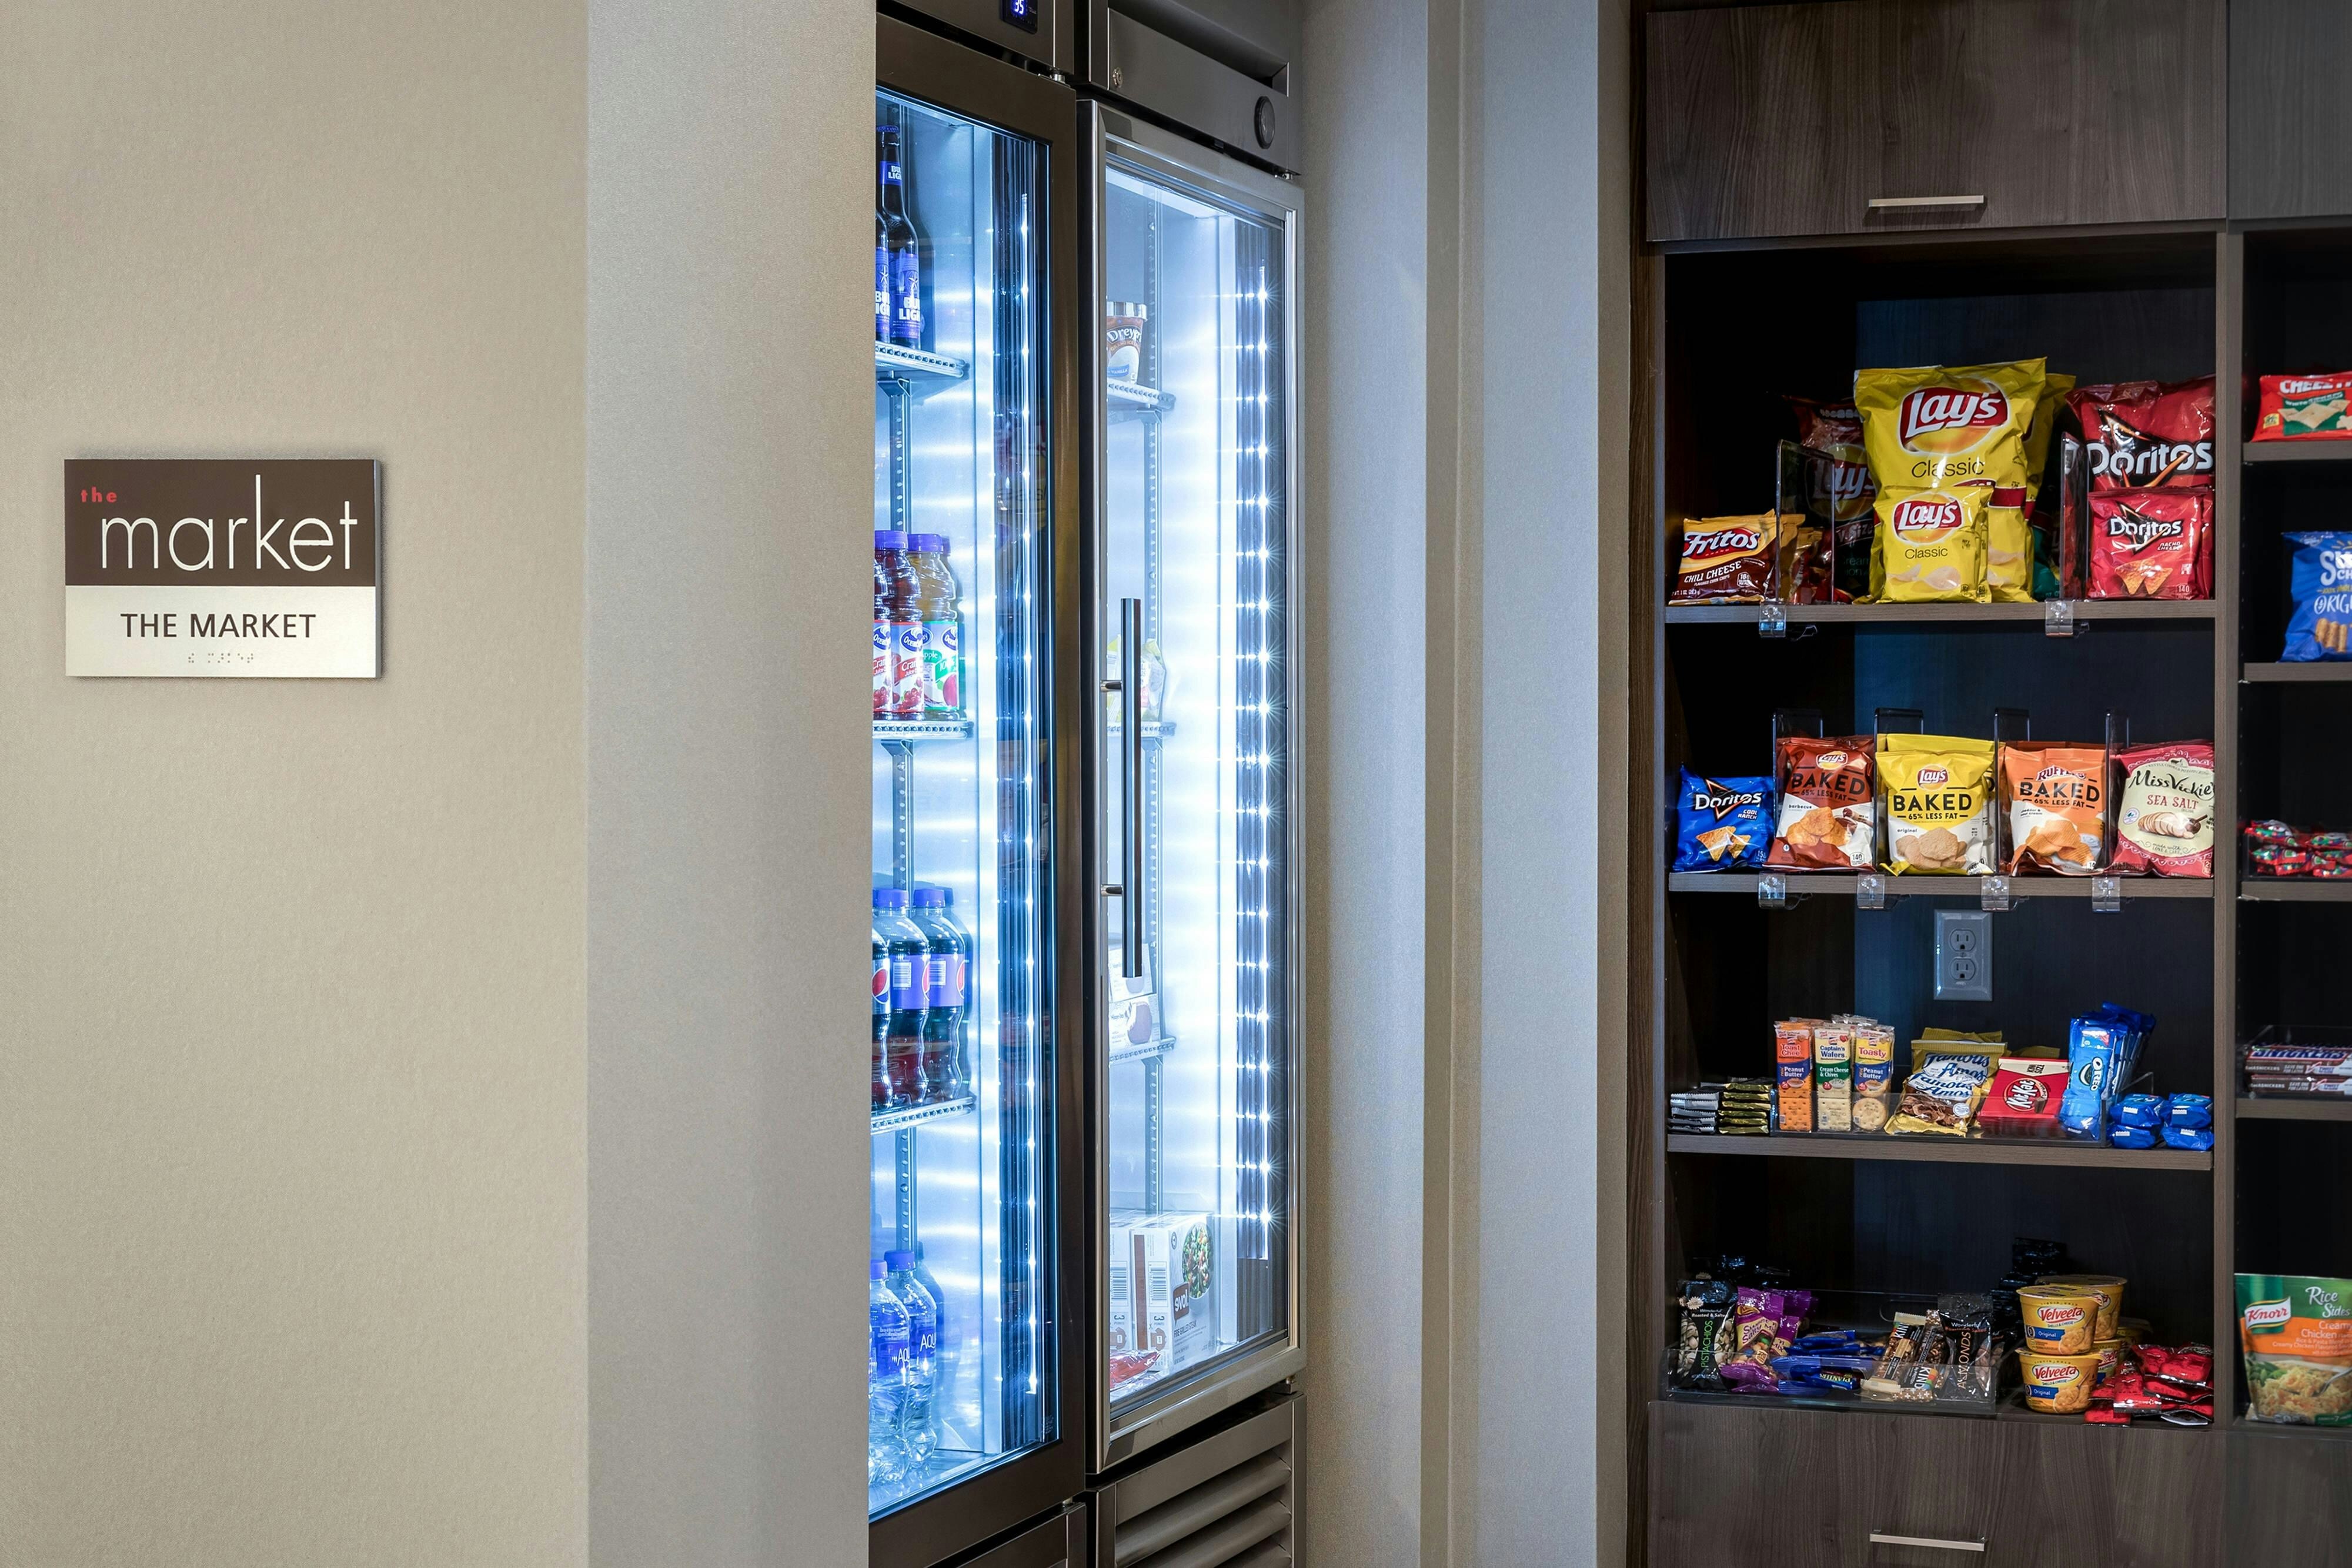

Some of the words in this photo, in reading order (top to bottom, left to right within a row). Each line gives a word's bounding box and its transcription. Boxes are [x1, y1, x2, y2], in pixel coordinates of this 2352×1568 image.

[888, 172, 901, 180] LIG
[899, 308, 920, 321] LIG
[1905, 392, 2001, 438] Lay's
[1912, 457, 1984, 477] Classic
[2086, 442, 2213, 476] Doritos
[81, 486, 117, 502] the
[101, 474, 358, 572] market
[1898, 503, 1957, 530] Lay's
[2110, 518, 2182, 536] Doritos
[1682, 531, 1760, 556] Fritos
[1905, 547, 1948, 559] Classic
[1684, 573, 1704, 583] CHILI
[1706, 561, 1742, 579] CHEESE
[2337, 569, 2352, 580] CH
[121, 613, 177, 638] THE
[189, 613, 316, 638] MARKET
[1792, 772, 1865, 795] BAKED
[1919, 769, 1946, 784] Lay's
[2129, 770, 2169, 789] Miss
[2167, 773, 2215, 796] Vickie'
[2020, 782, 2100, 802] BAKED
[1695, 793, 1763, 810] Doritos
[1893, 794, 1972, 811] BAKED
[2147, 794, 2167, 806] SEA
[2173, 797, 2199, 810] SALT
[1859, 1047, 1887, 1058] Toasty
[2090, 1057, 2103, 1092] OREO
[1916, 1086, 1970, 1097] Amos
[2305, 1286, 2338, 1305] Rice
[2041, 1307, 2083, 1321] Velveeta
[2247, 1308, 2288, 1322] Knorr
[2322, 1303, 2350, 1318] Sides
[1893, 1323, 1909, 1338] KIN
[2301, 1329, 2337, 1339] Chicken
[920, 1332, 936, 1352] AQU
[1701, 1320, 1713, 1368] PISTACHIOS
[897, 1348, 909, 1366] AQ
[1914, 1366, 1932, 1388] KIND
[2035, 1366, 2077, 1379] Velveeta
